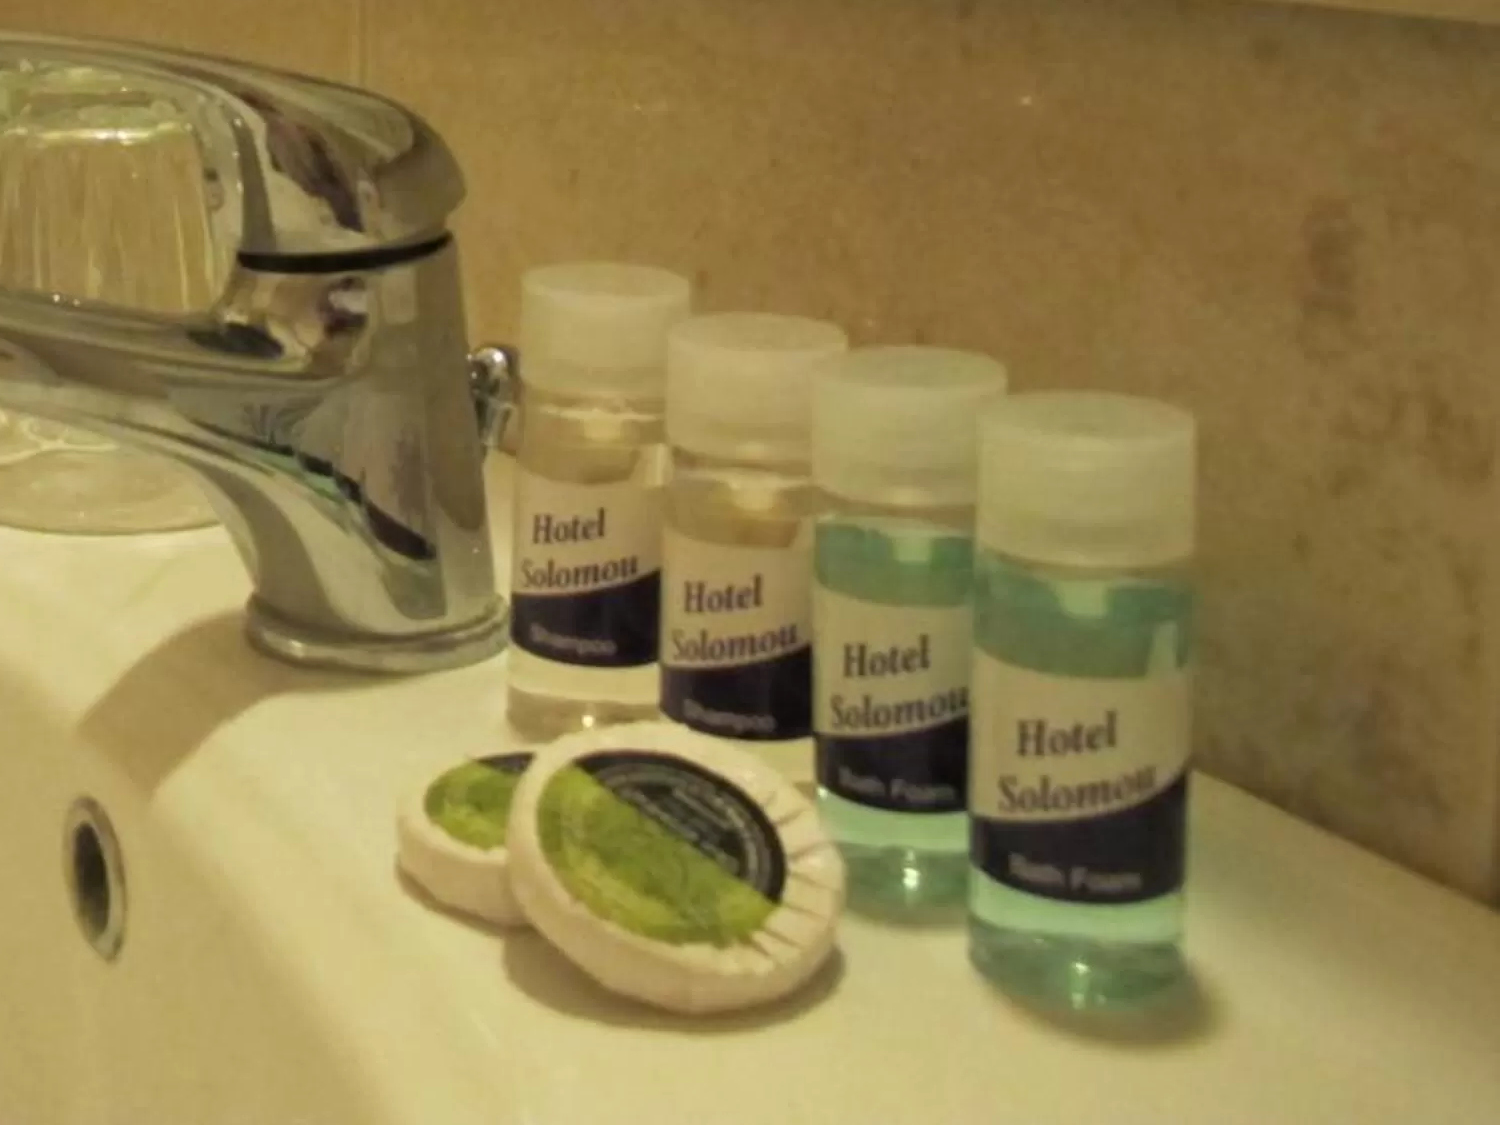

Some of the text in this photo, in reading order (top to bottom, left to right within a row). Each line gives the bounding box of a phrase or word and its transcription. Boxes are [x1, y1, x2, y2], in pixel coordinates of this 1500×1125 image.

[532, 507, 606, 544] Hotel
[521, 556, 639, 589] Solomou
[684, 574, 763, 613] Hotel
[671, 625, 799, 663] Solomou
[843, 634, 931, 677] Hotel
[830, 686, 968, 729] Solomou
[1017, 711, 1118, 757] Hotel
[998, 767, 1156, 812] Solomou
